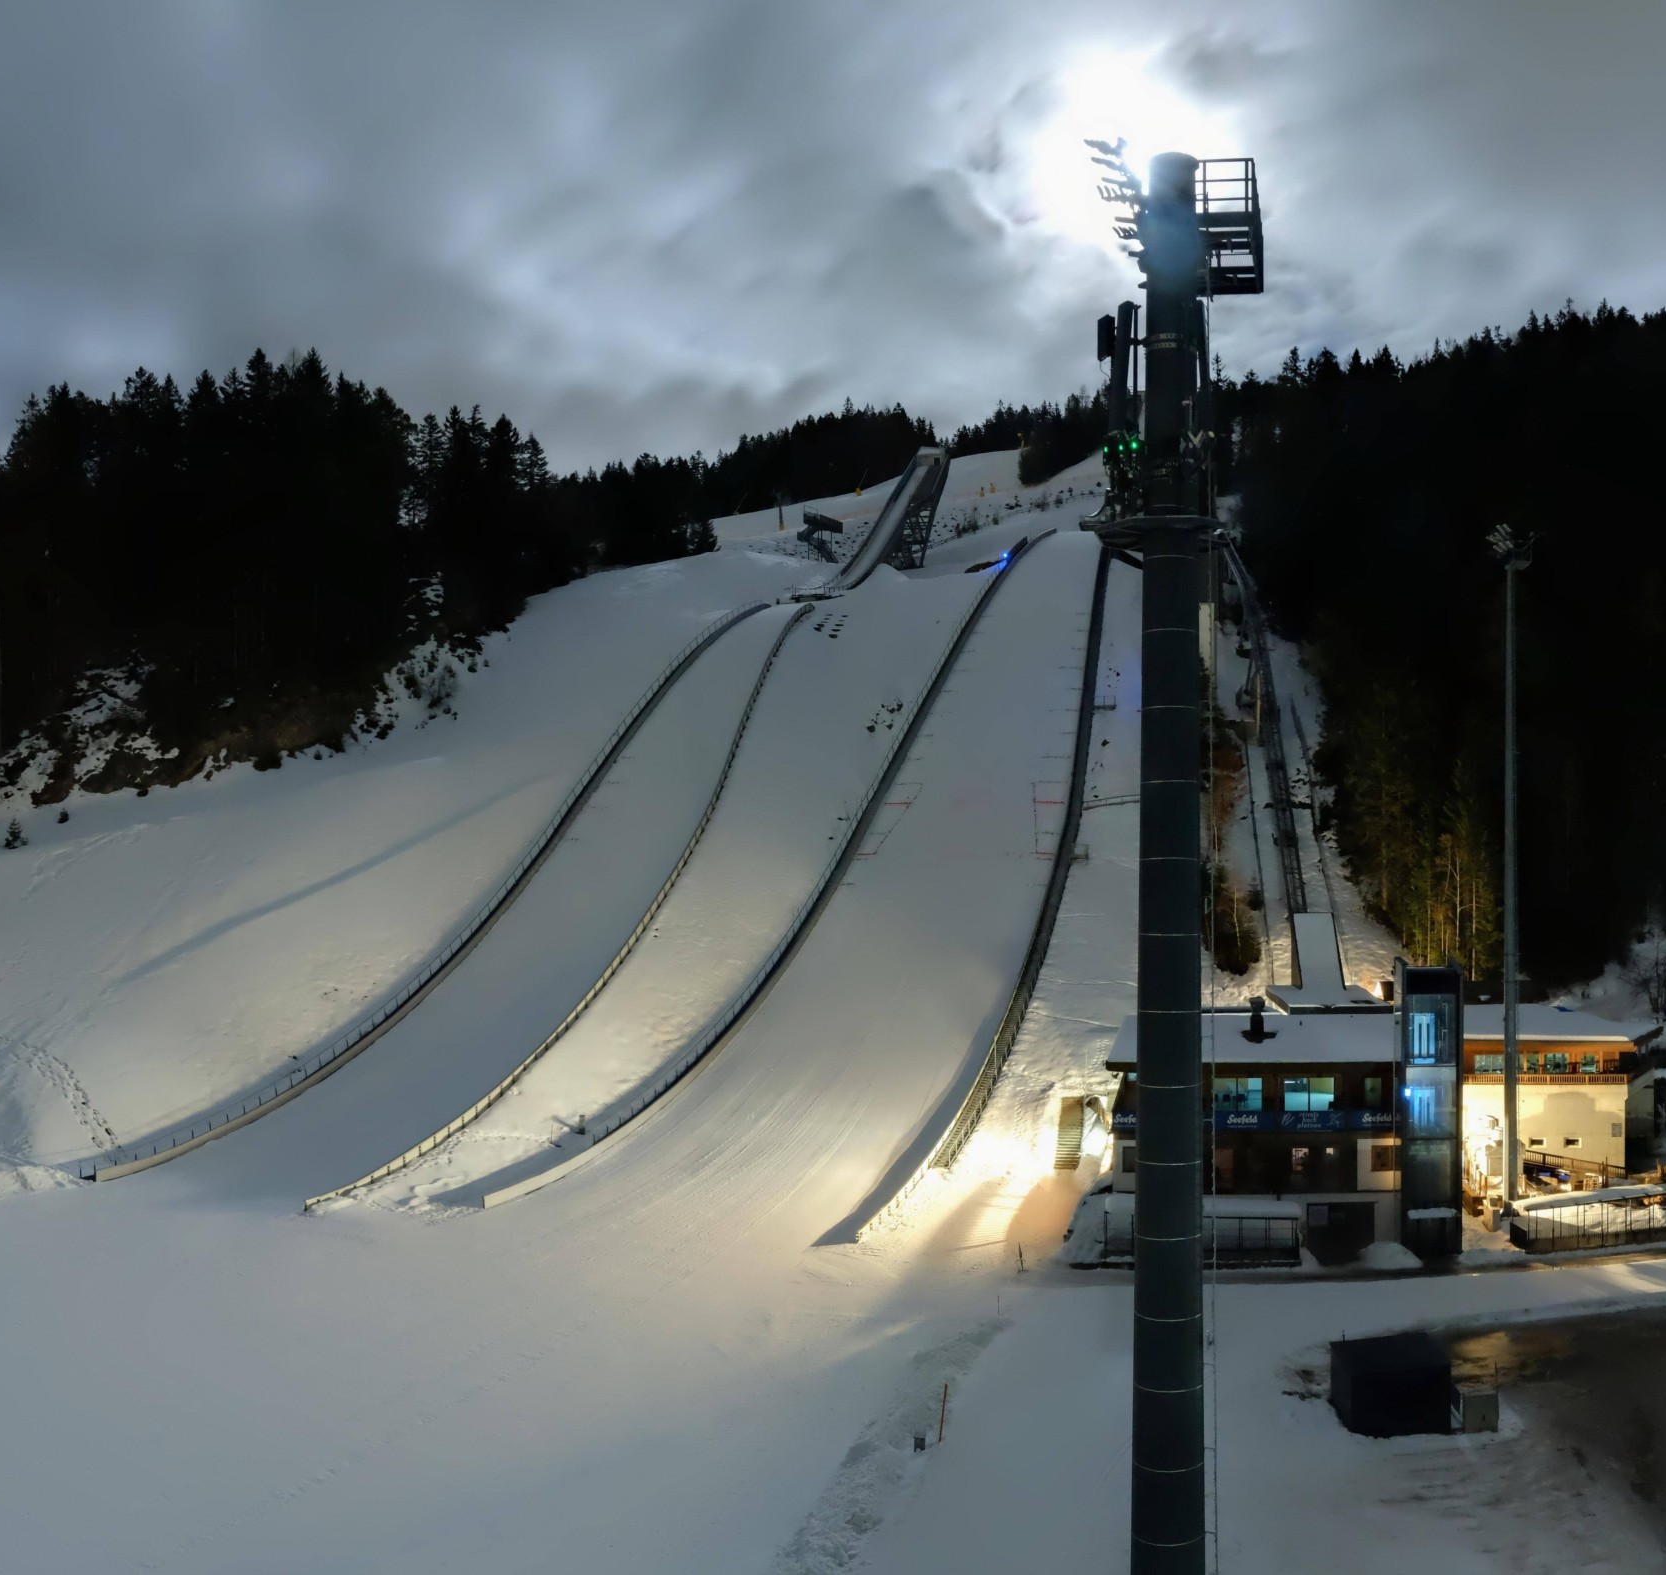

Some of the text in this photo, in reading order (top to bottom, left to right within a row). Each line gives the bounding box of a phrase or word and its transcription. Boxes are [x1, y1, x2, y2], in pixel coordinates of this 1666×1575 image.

[1113, 1113, 1136, 1125] Seefe
[1226, 1114, 1258, 1125] Seefeld
[1361, 1113, 1392, 1123] Seefeld
